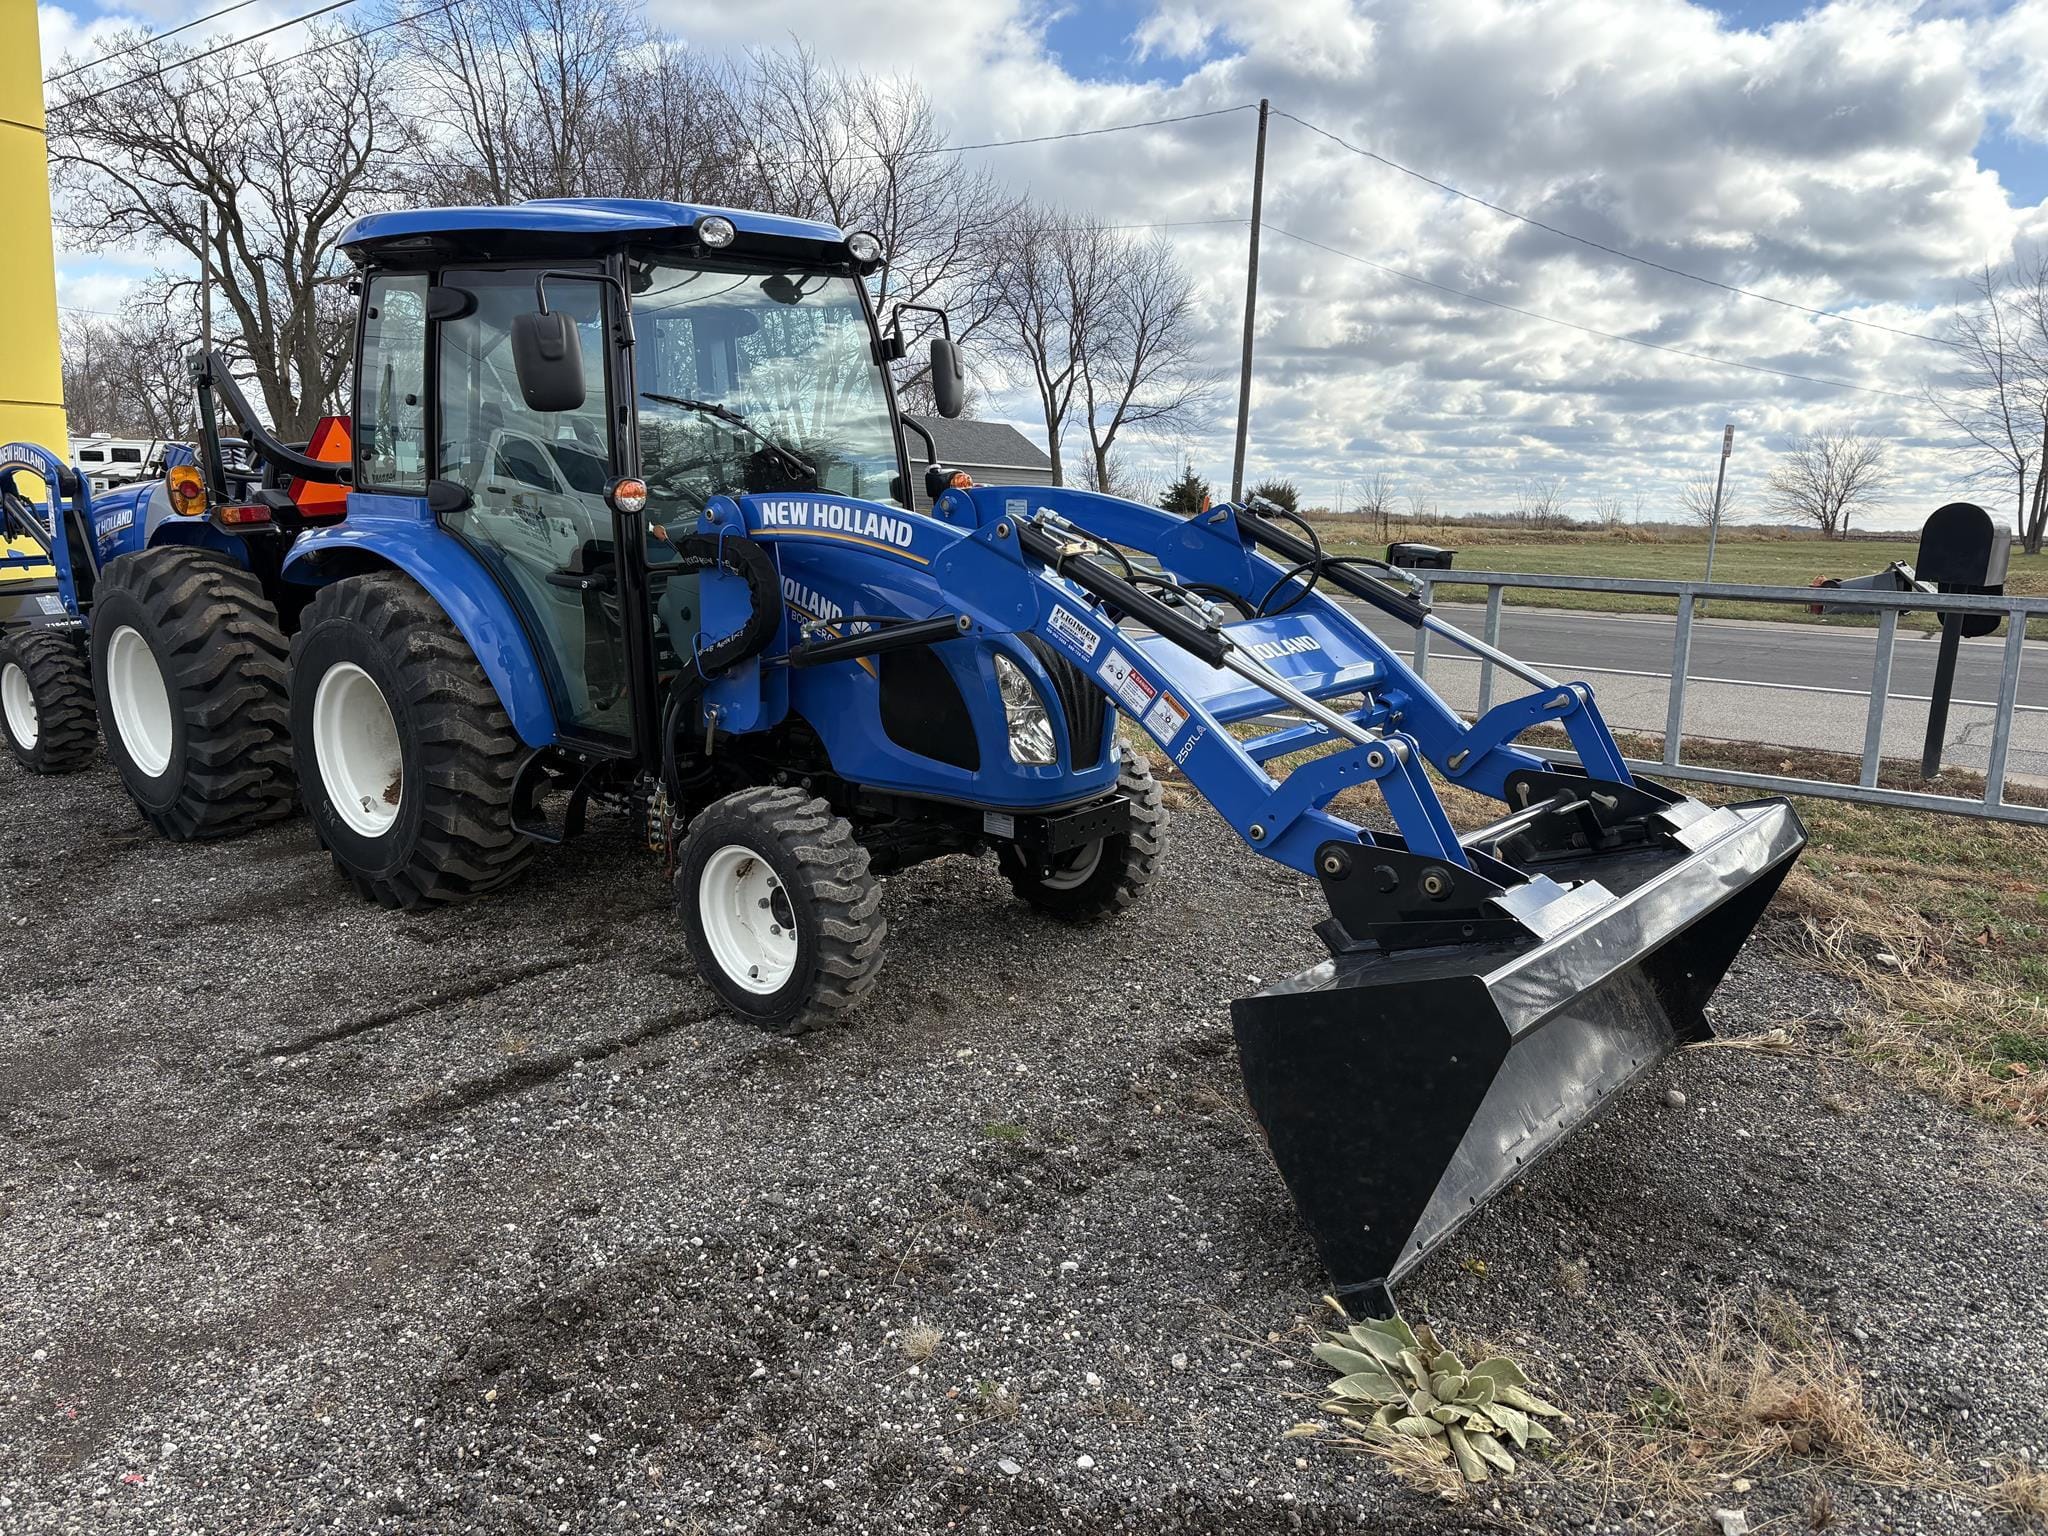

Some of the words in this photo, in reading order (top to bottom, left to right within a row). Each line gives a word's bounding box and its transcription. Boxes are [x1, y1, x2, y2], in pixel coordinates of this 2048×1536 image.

[13, 445, 46, 474] HOLLAND
[101, 510, 133, 534] HOLLAND
[762, 502, 809, 526] NEW
[813, 503, 913, 548] HOLLAND
[781, 575, 843, 630] OLLAND
[1056, 608, 1097, 643] FLIGINGER
[1175, 725, 1207, 765] 250TLA
